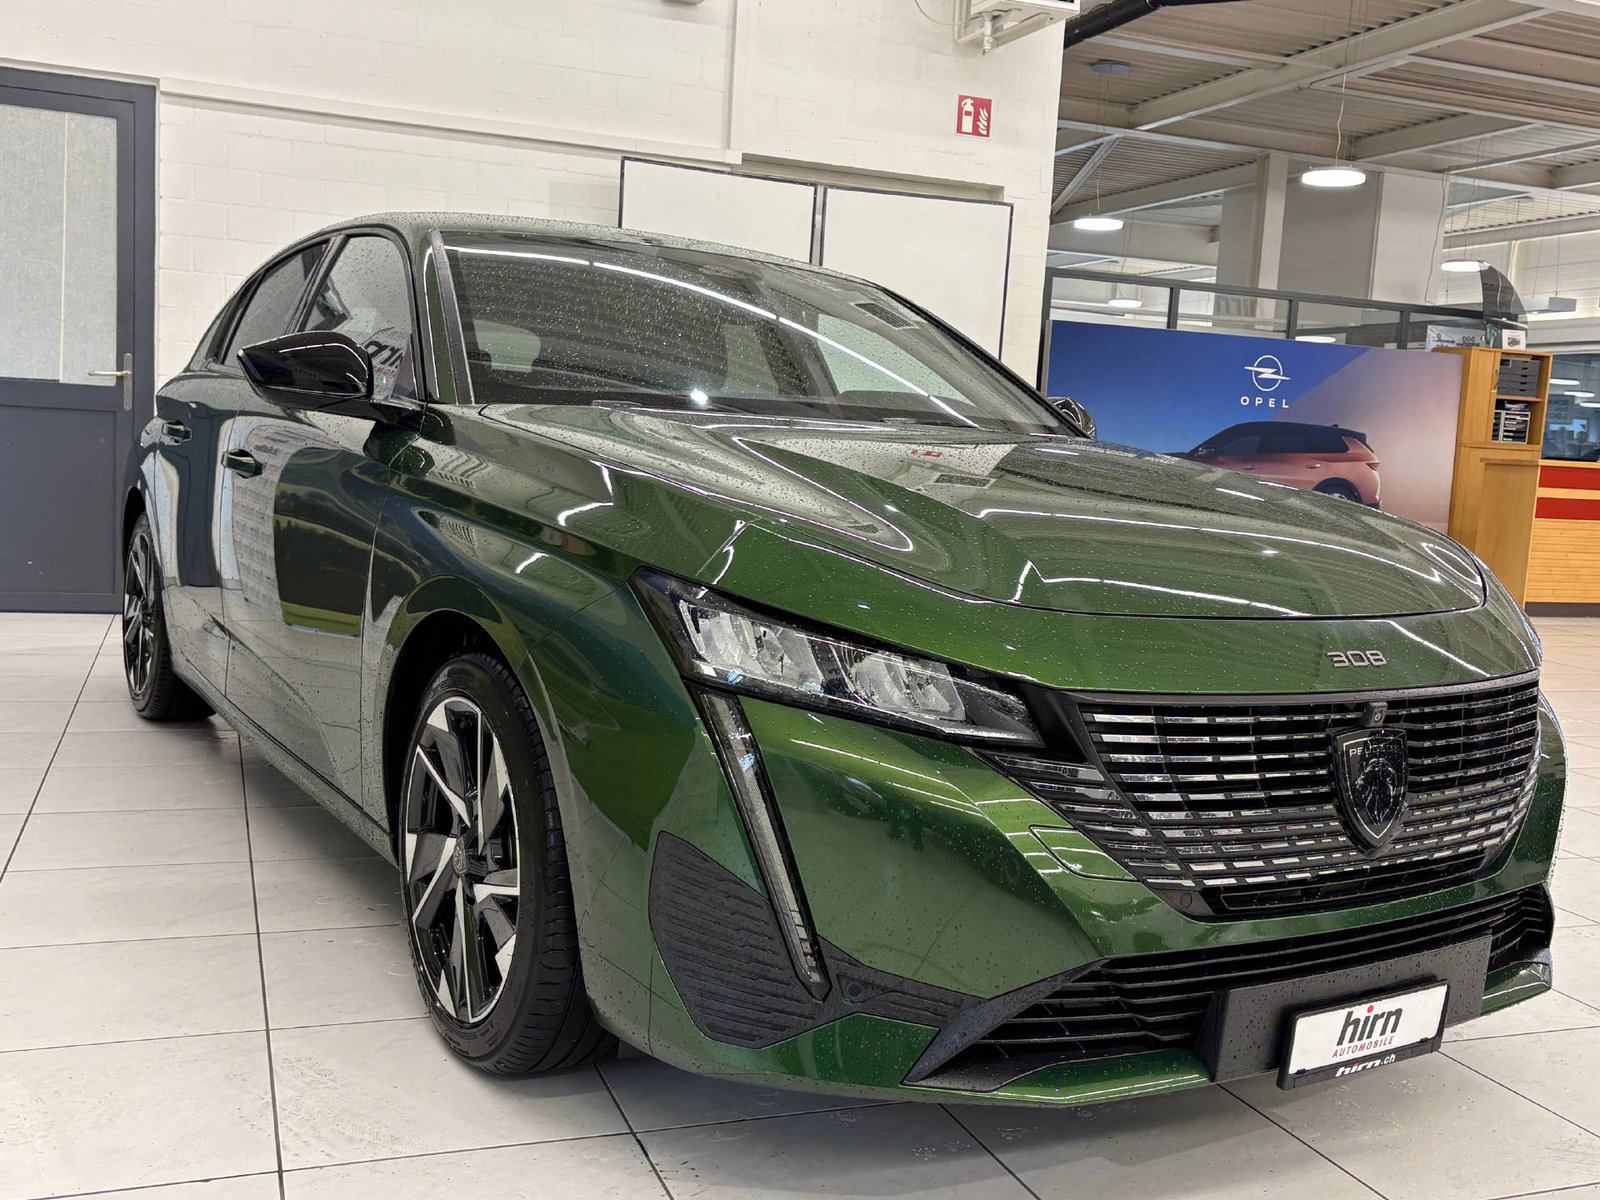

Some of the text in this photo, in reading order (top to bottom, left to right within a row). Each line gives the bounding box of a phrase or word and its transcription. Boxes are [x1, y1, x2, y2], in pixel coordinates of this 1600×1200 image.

[1240, 395, 1290, 409] OPEL
[1326, 650, 1387, 667] 308
[1336, 1004, 1403, 1046] hirn
[1331, 1035, 1394, 1059] AUTOMOBILE
[1335, 1053, 1396, 1077] hirn.ch
